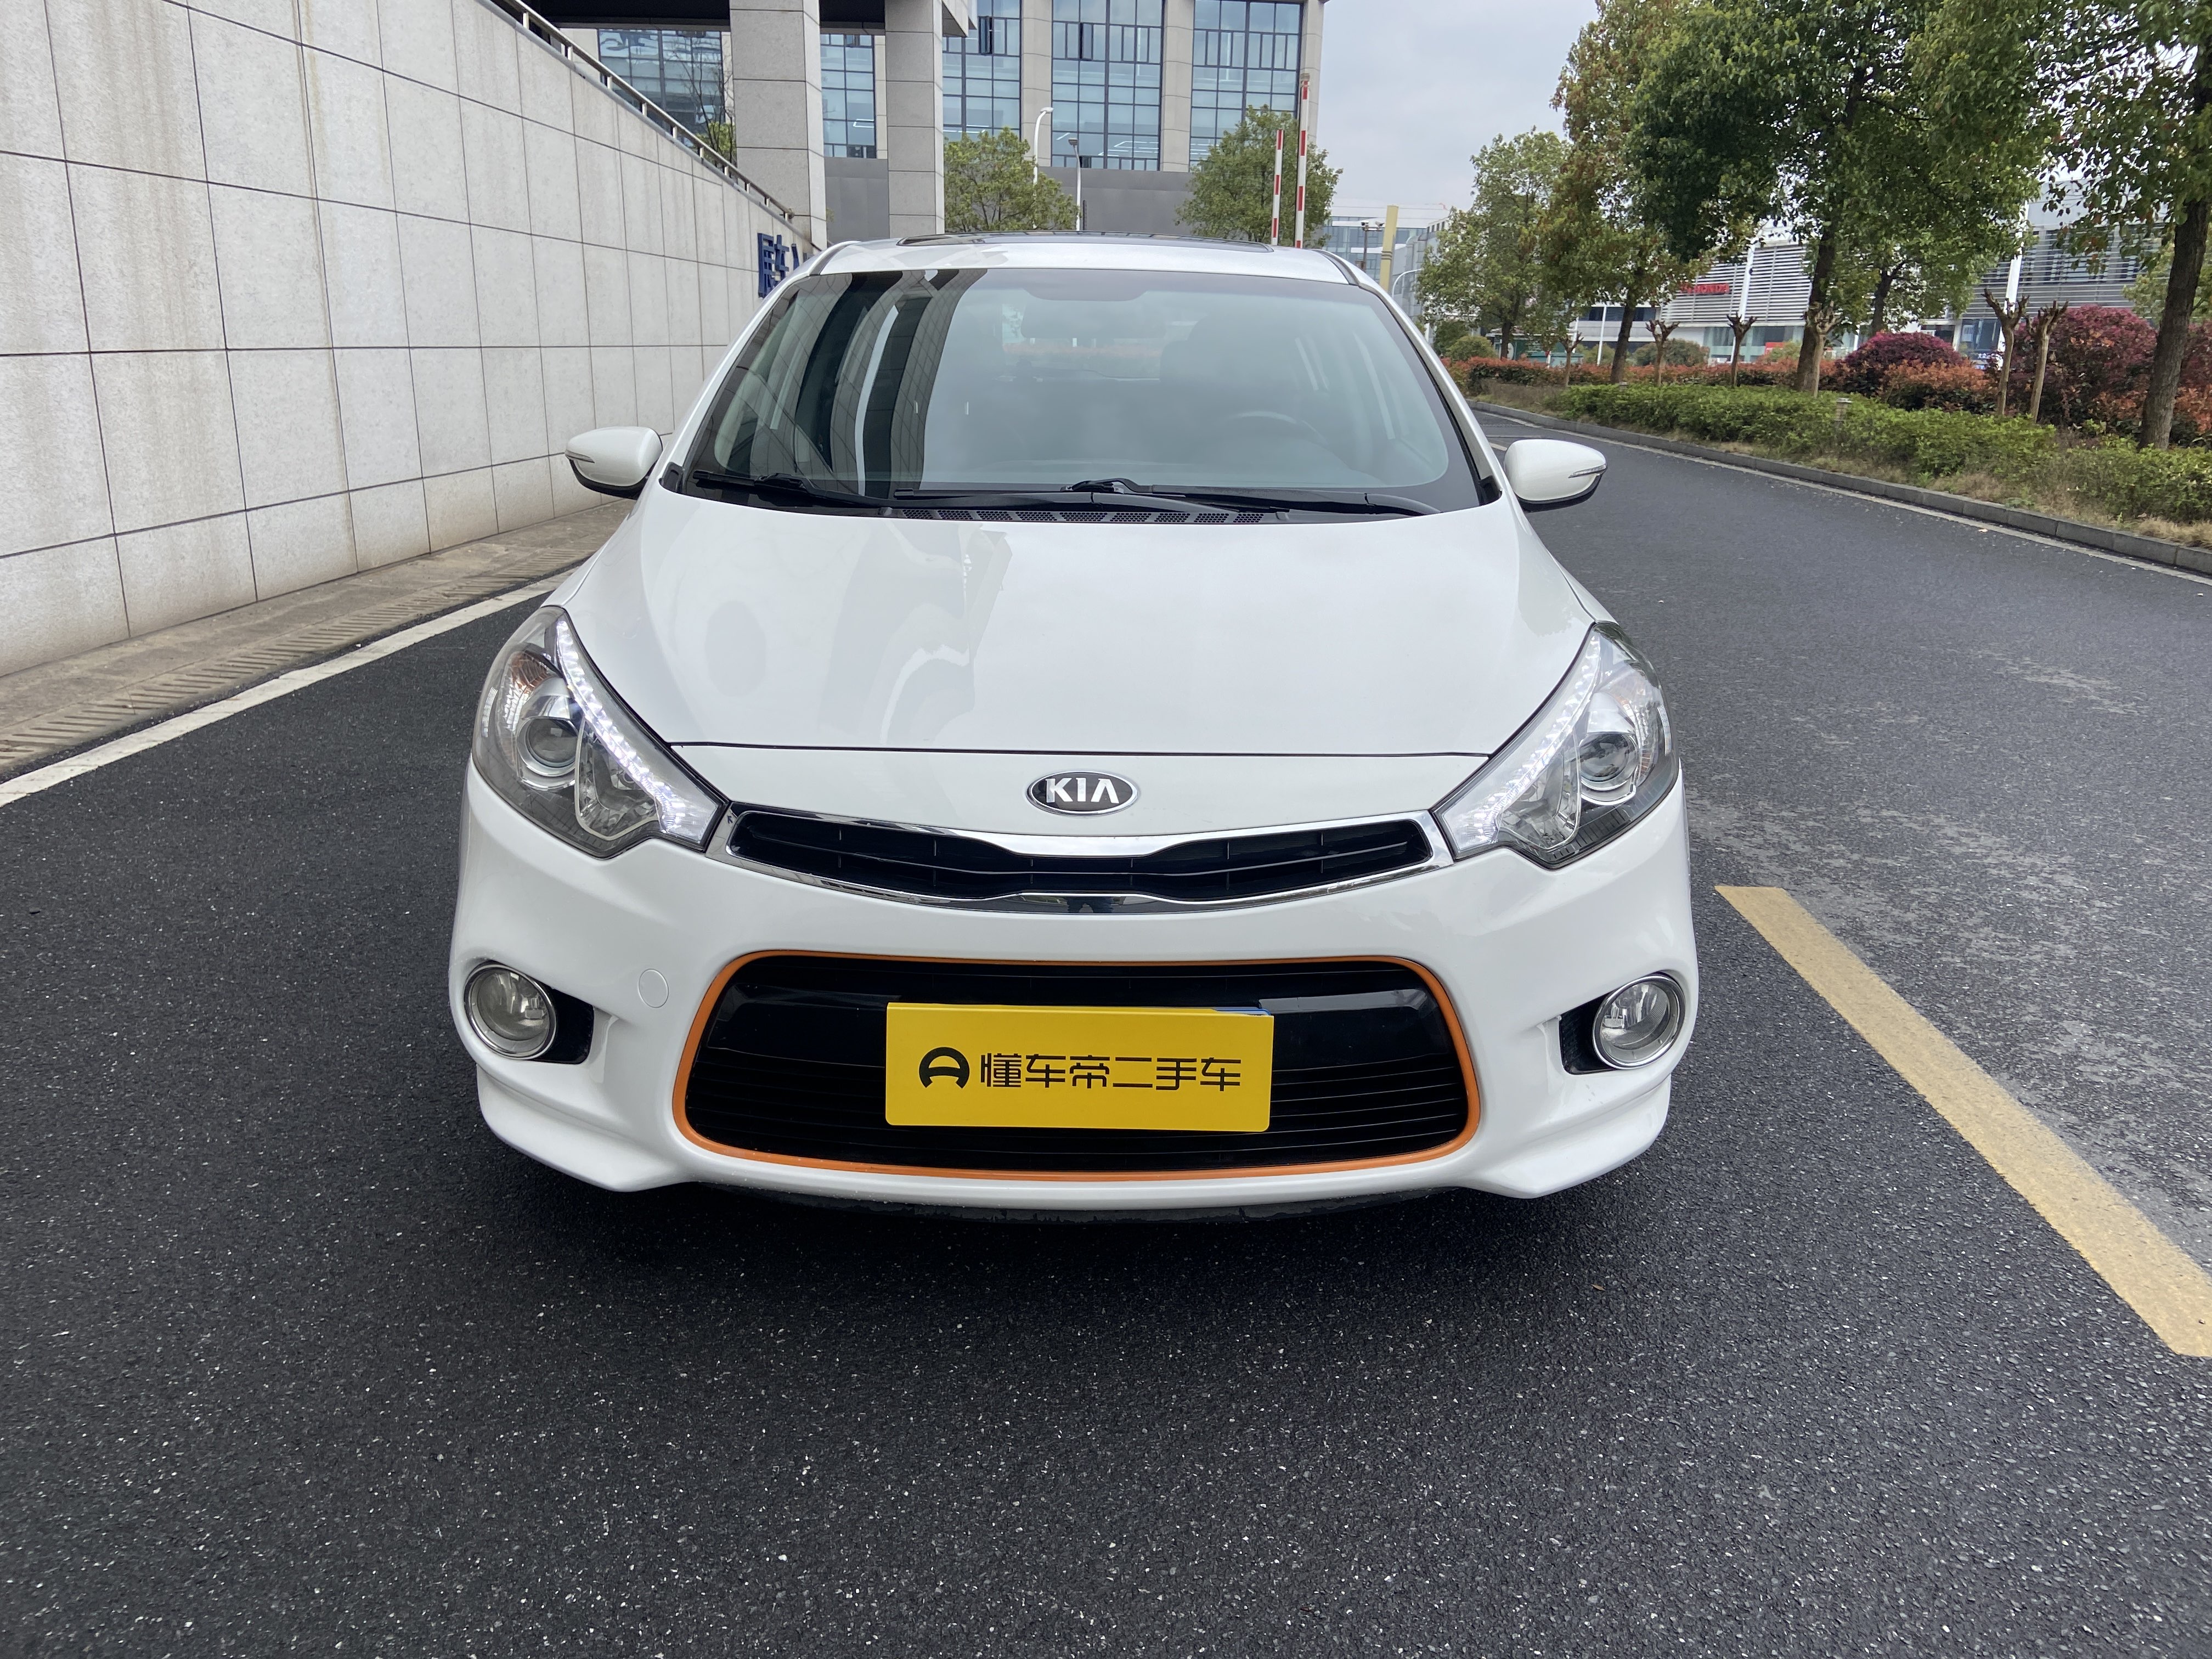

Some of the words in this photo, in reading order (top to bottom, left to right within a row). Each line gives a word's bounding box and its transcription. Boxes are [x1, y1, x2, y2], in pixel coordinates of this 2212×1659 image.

[1045, 777, 1120, 804] KIA
[981, 1053, 1242, 1092] 懂车帝二手车
